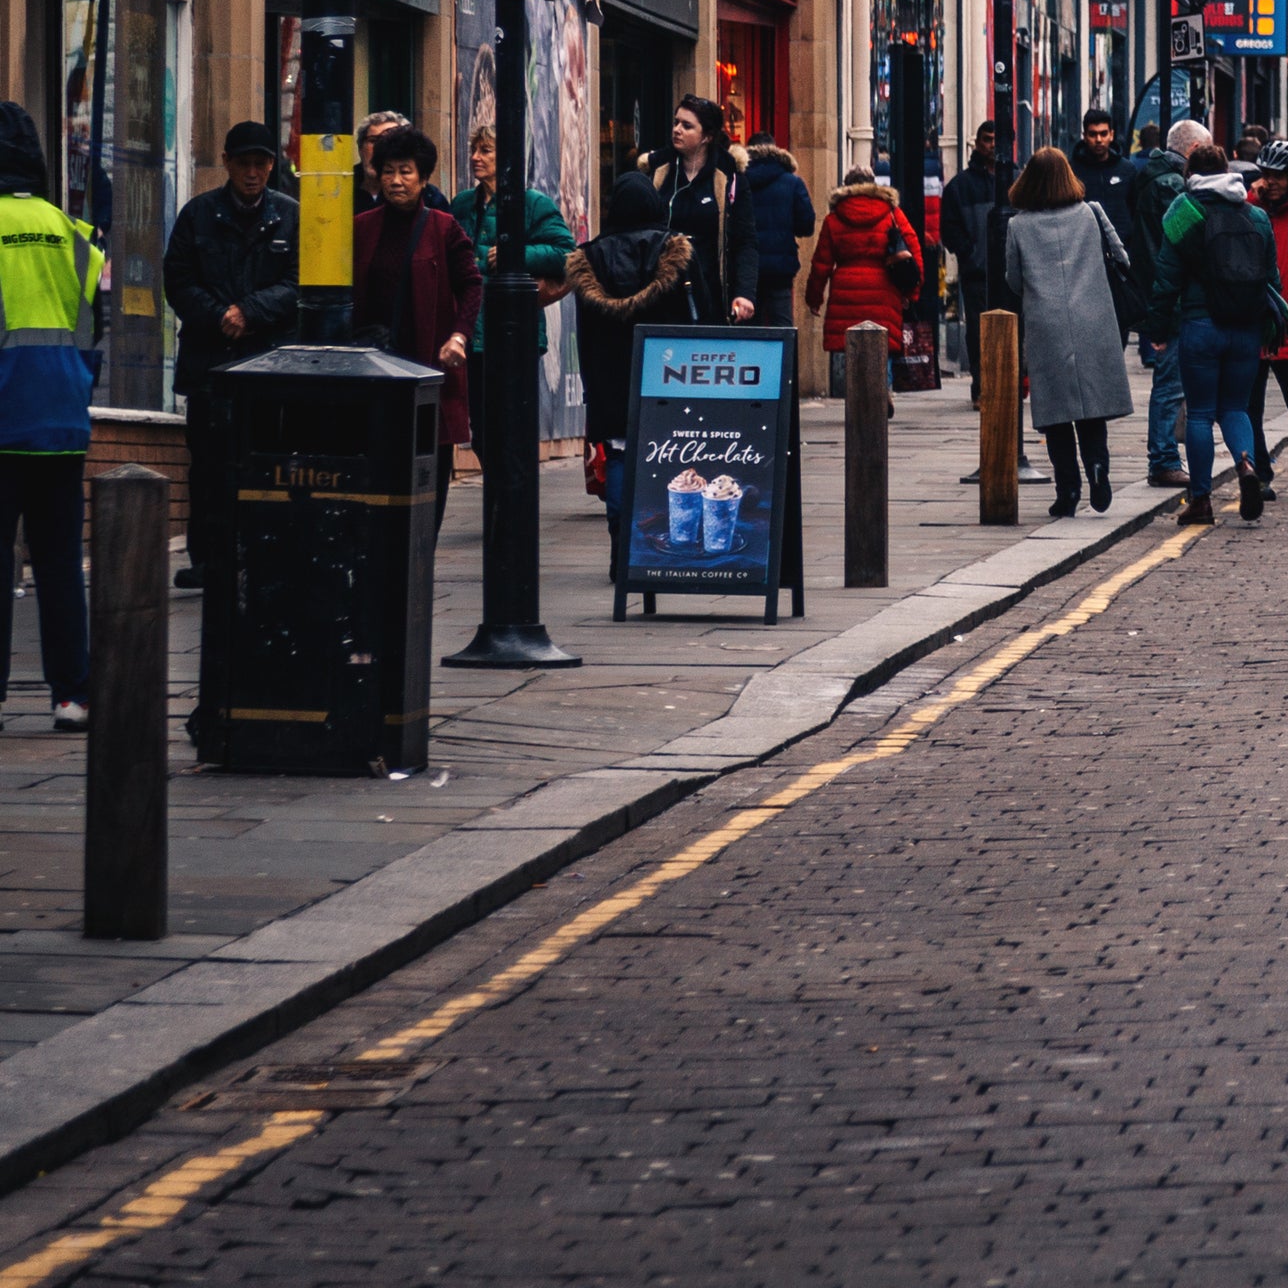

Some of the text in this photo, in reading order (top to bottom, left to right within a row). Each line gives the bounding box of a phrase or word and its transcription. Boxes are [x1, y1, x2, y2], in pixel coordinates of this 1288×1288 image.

[1235, 38, 1274, 49] GREGGS
[1, 233, 19, 245] BIG
[19, 232, 44, 243] ISSUE
[691, 351, 736, 362] CAFFÈ
[662, 364, 761, 386] NERO
[672, 430, 742, 439] SWEET & SPICED
[645, 440, 766, 465] Hot Chocolates
[275, 464, 342, 488] Litter
[647, 569, 662, 578] THE
[665, 570, 699, 579] ITALIAN
[701, 571, 733, 579] COFFEE
